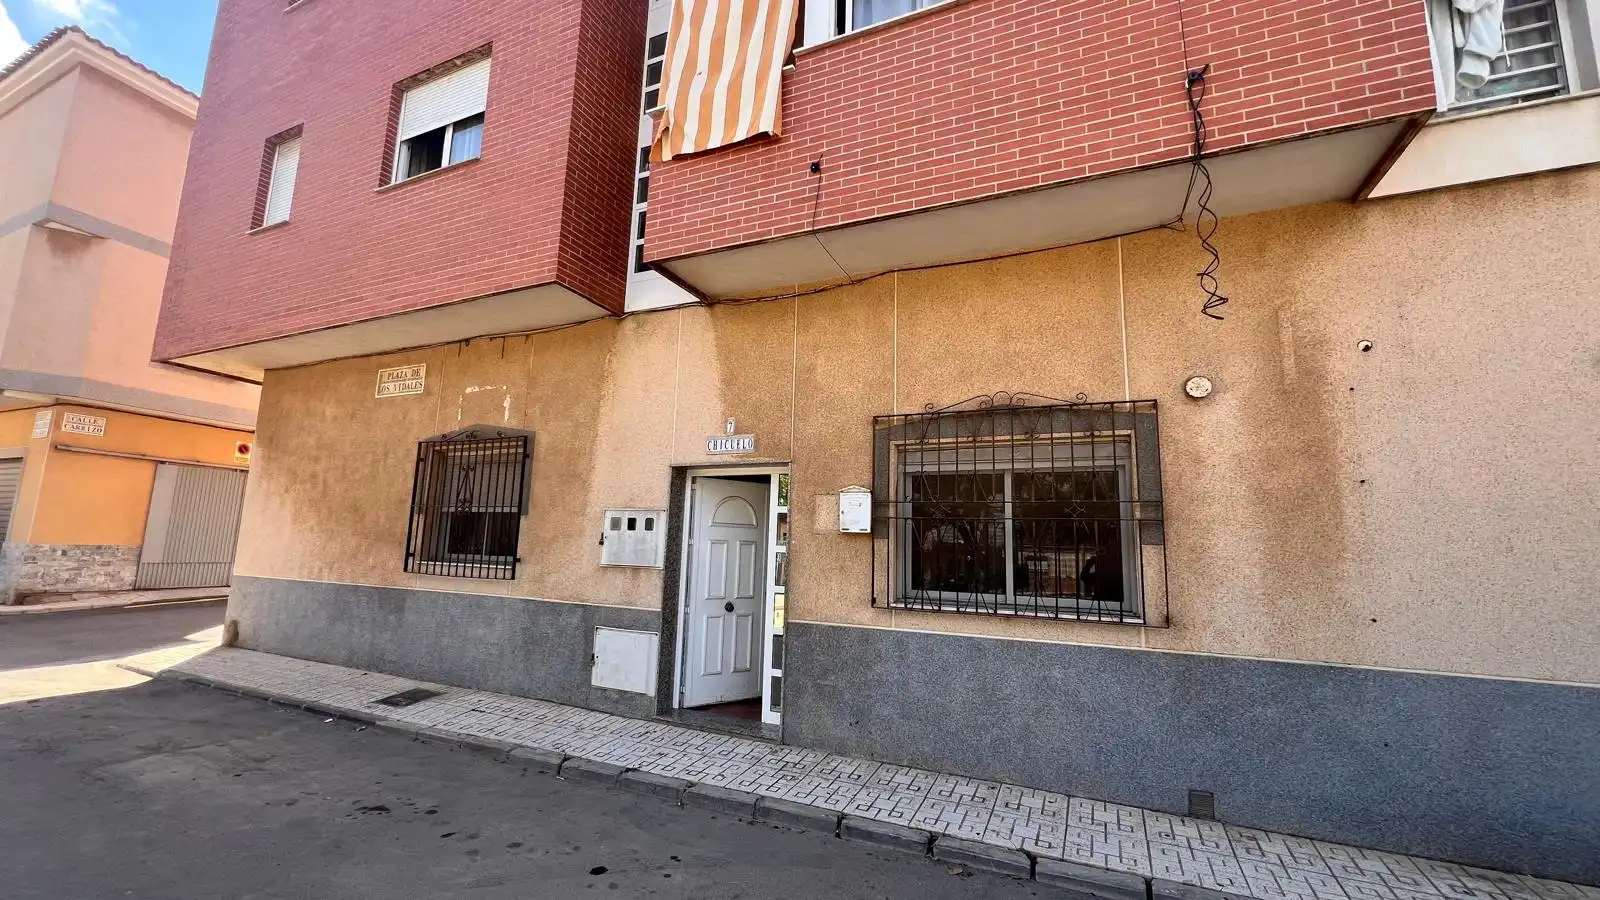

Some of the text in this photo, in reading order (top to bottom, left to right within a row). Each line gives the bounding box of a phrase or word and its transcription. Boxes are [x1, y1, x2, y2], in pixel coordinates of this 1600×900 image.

[387, 368, 421, 380] PLAZA DE
[394, 381, 423, 391] VIDALES
[71, 416, 98, 425] CALLE
[728, 421, 733, 433] 7
[707, 438, 753, 451] CHICUELO
